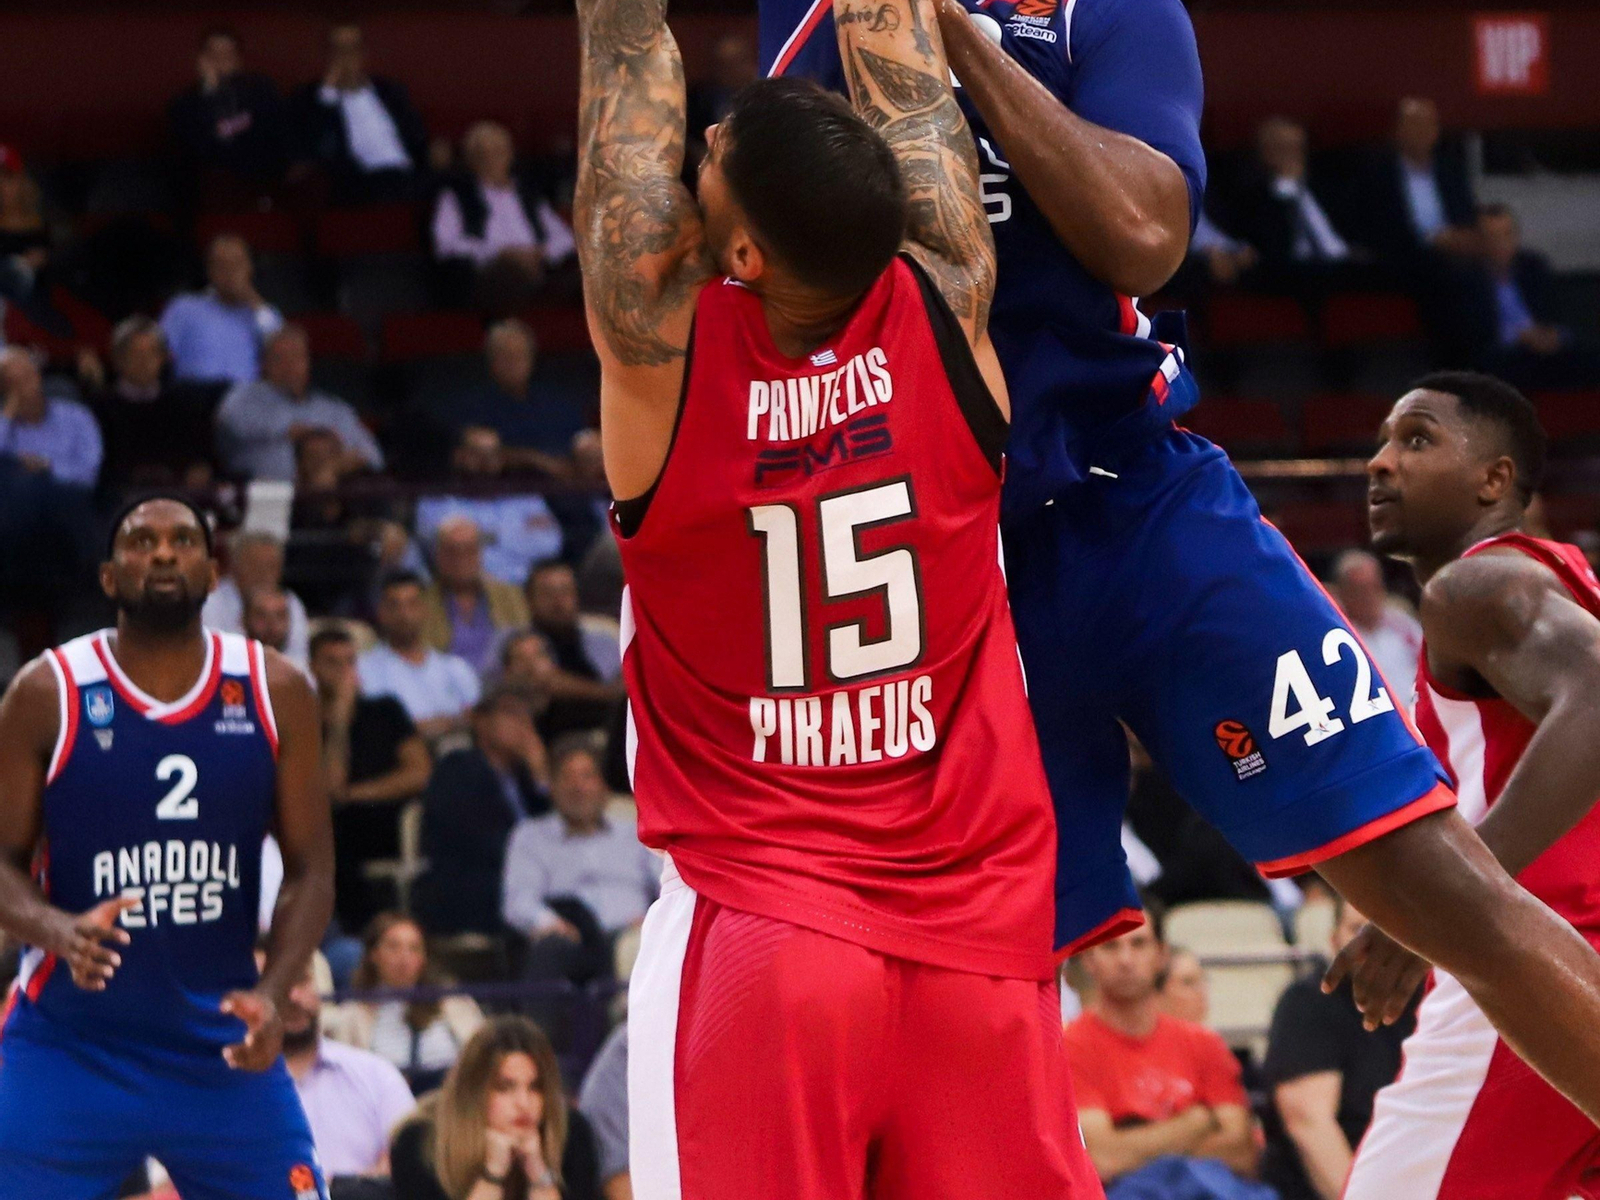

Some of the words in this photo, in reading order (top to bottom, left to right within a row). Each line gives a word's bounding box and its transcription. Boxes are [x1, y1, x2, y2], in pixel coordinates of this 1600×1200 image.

[1480, 22, 1541, 86] VIP
[747, 347, 893, 441] PRINTEZIS
[746, 476, 924, 691] 15
[749, 675, 937, 767] PIRAEUS
[1268, 627, 1395, 747] 42
[155, 754, 199, 820] 2
[120, 880, 224, 928] EFES
